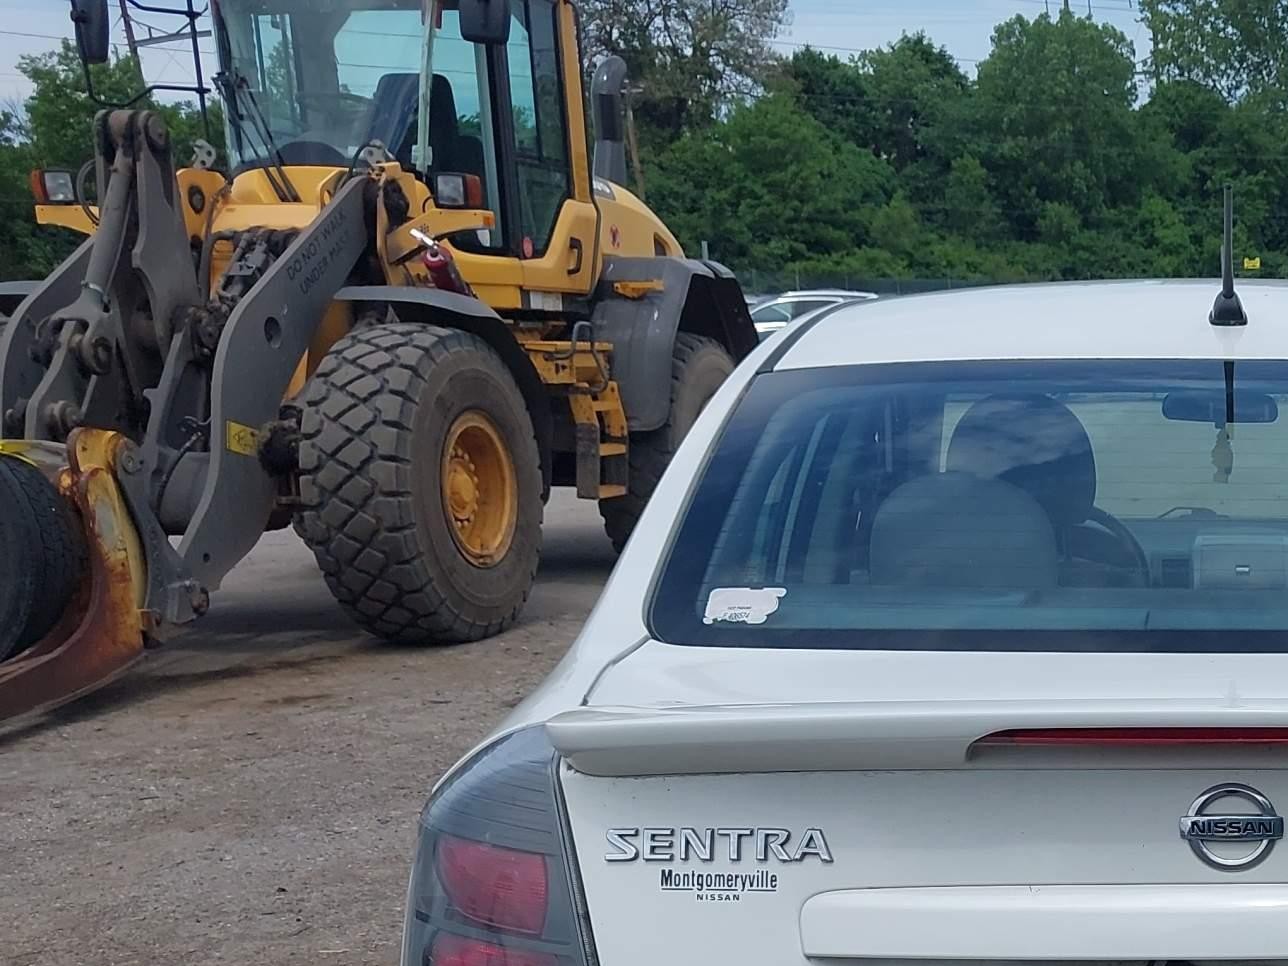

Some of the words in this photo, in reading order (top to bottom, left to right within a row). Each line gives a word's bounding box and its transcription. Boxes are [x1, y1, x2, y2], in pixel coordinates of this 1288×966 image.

[1190, 821, 1273, 835] NISSAN
[604, 827, 835, 864] SENTRA
[660, 869, 778, 892] Montgomeryville
[696, 894, 741, 902] NISSAN
